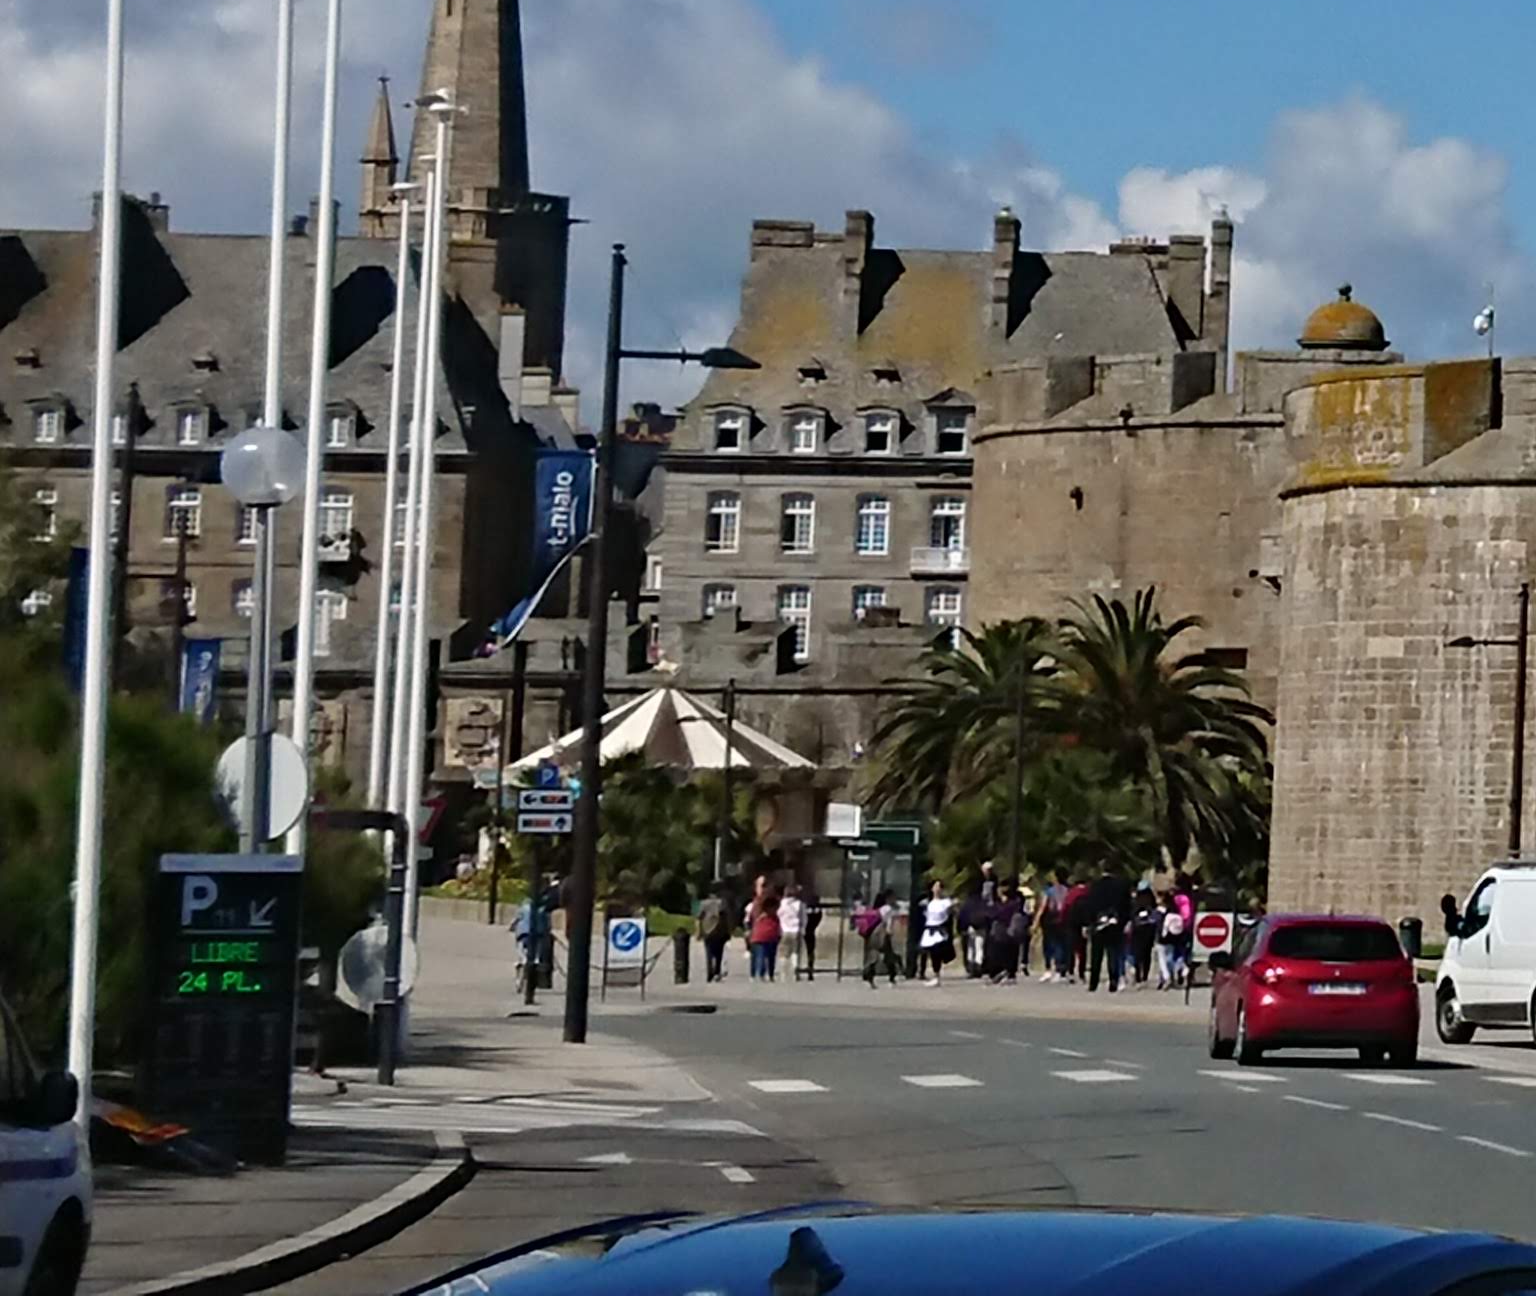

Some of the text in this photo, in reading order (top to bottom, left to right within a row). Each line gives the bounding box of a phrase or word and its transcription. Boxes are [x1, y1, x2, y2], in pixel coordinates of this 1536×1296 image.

[181, 875, 218, 926] P
[192, 941, 259, 963] LIBRE
[178, 971, 261, 992] 24 PL.
